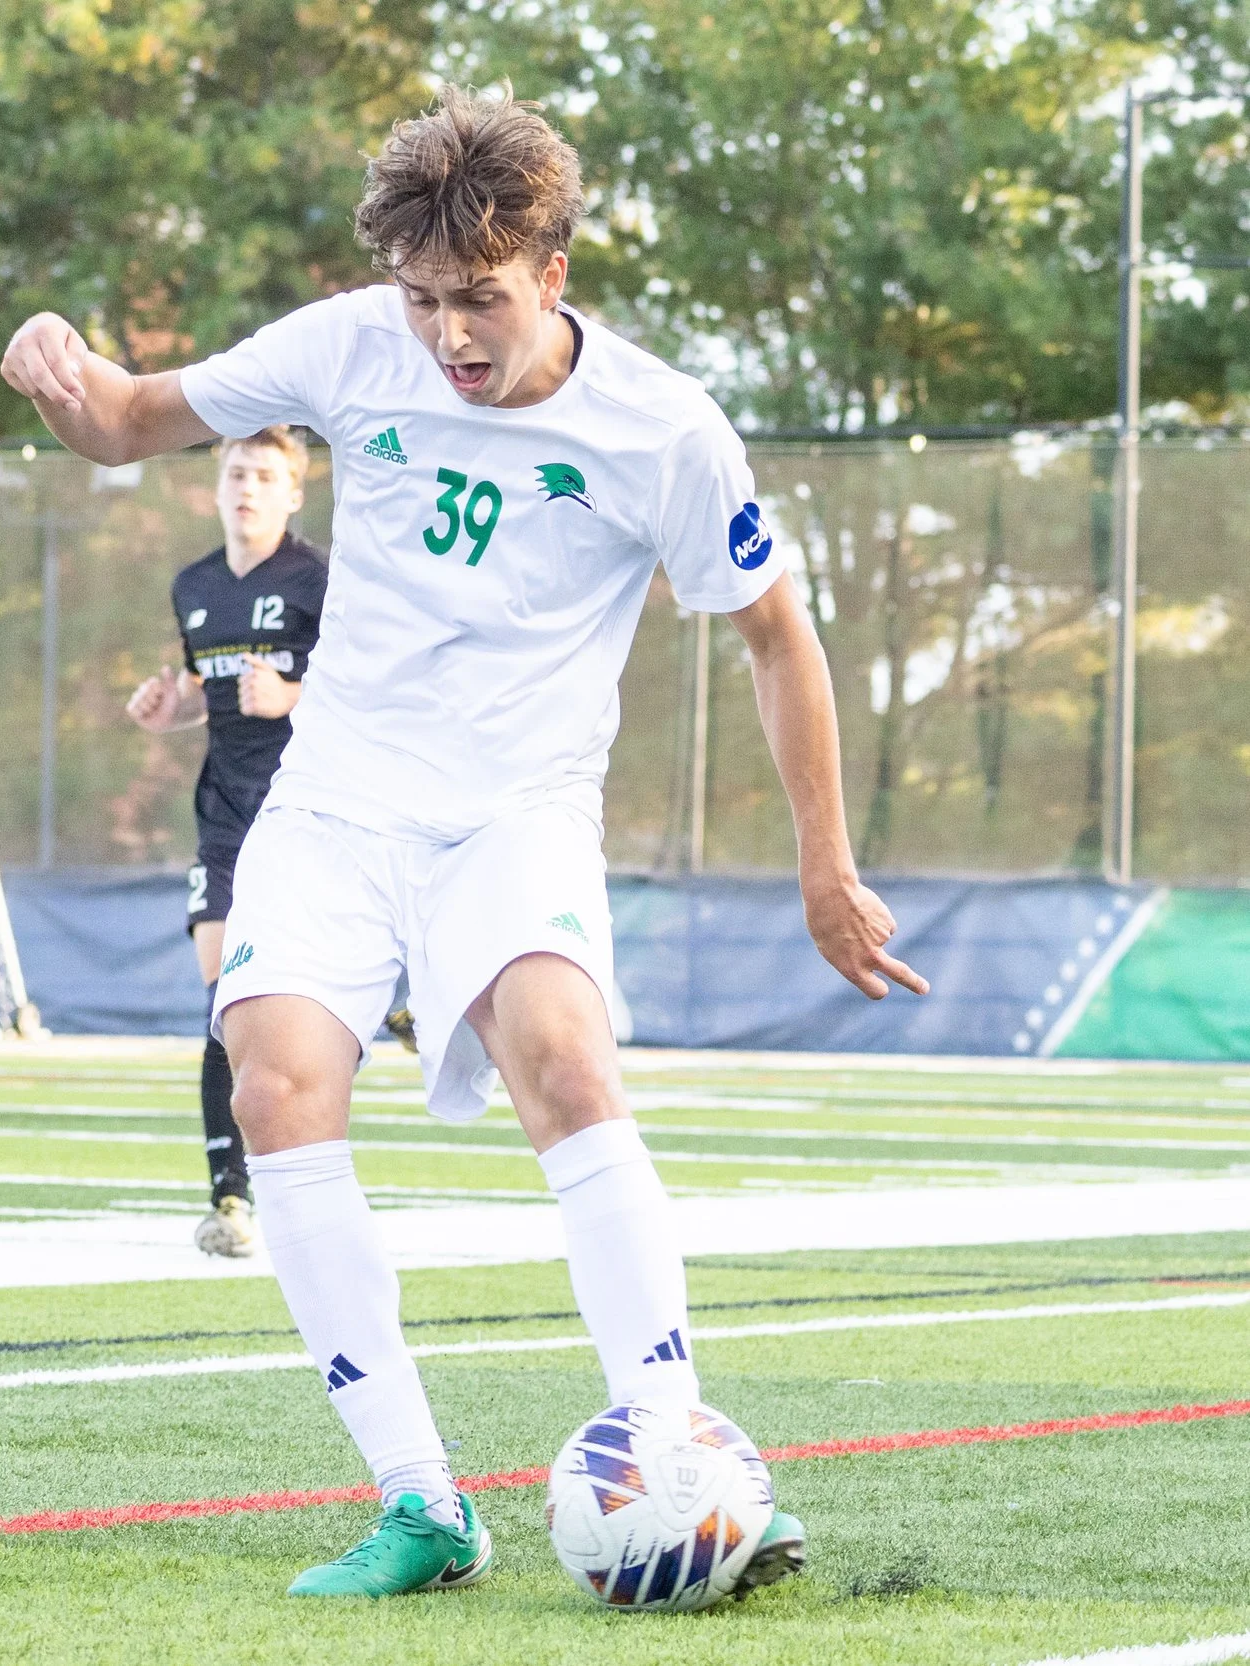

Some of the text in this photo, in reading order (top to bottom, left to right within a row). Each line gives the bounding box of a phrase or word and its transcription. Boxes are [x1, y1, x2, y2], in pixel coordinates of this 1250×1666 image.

[363, 442, 408, 465] adidas
[422, 466, 503, 567] 39
[251, 594, 285, 630] 12
